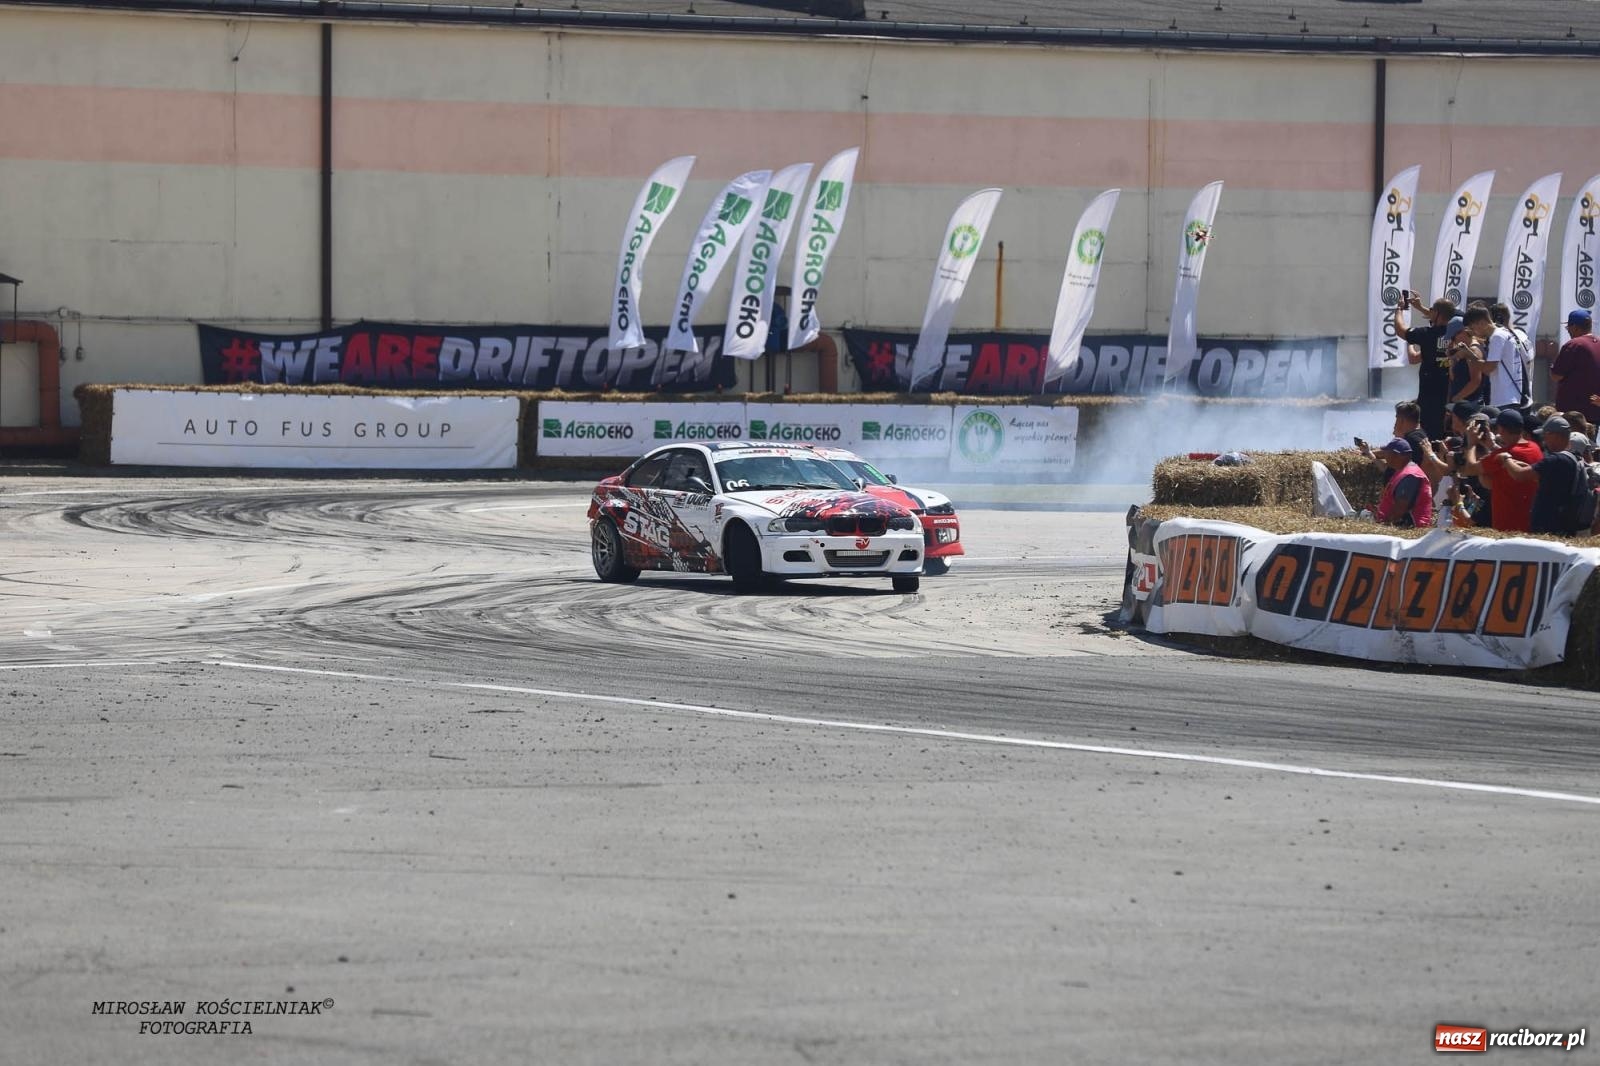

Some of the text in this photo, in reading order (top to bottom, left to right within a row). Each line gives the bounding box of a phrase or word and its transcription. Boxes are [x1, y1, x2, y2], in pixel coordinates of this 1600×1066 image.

[618, 214, 652, 331] AGROEKO
[736, 222, 778, 339] AGROEKO
[1445, 250, 1464, 307] AGRO
[1512, 252, 1534, 333] AGRON
[1576, 251, 1596, 309] AGRO
[1381, 248, 1402, 362] AGRONOVA
[183, 418, 453, 440] AUTO FUS GROUP
[564, 420, 634, 440] AGROEKO
[674, 420, 742, 440] AGROEKO
[769, 422, 841, 442] AGROEKO
[884, 423, 947, 442] AGROEKO
[623, 511, 671, 549] STAG
